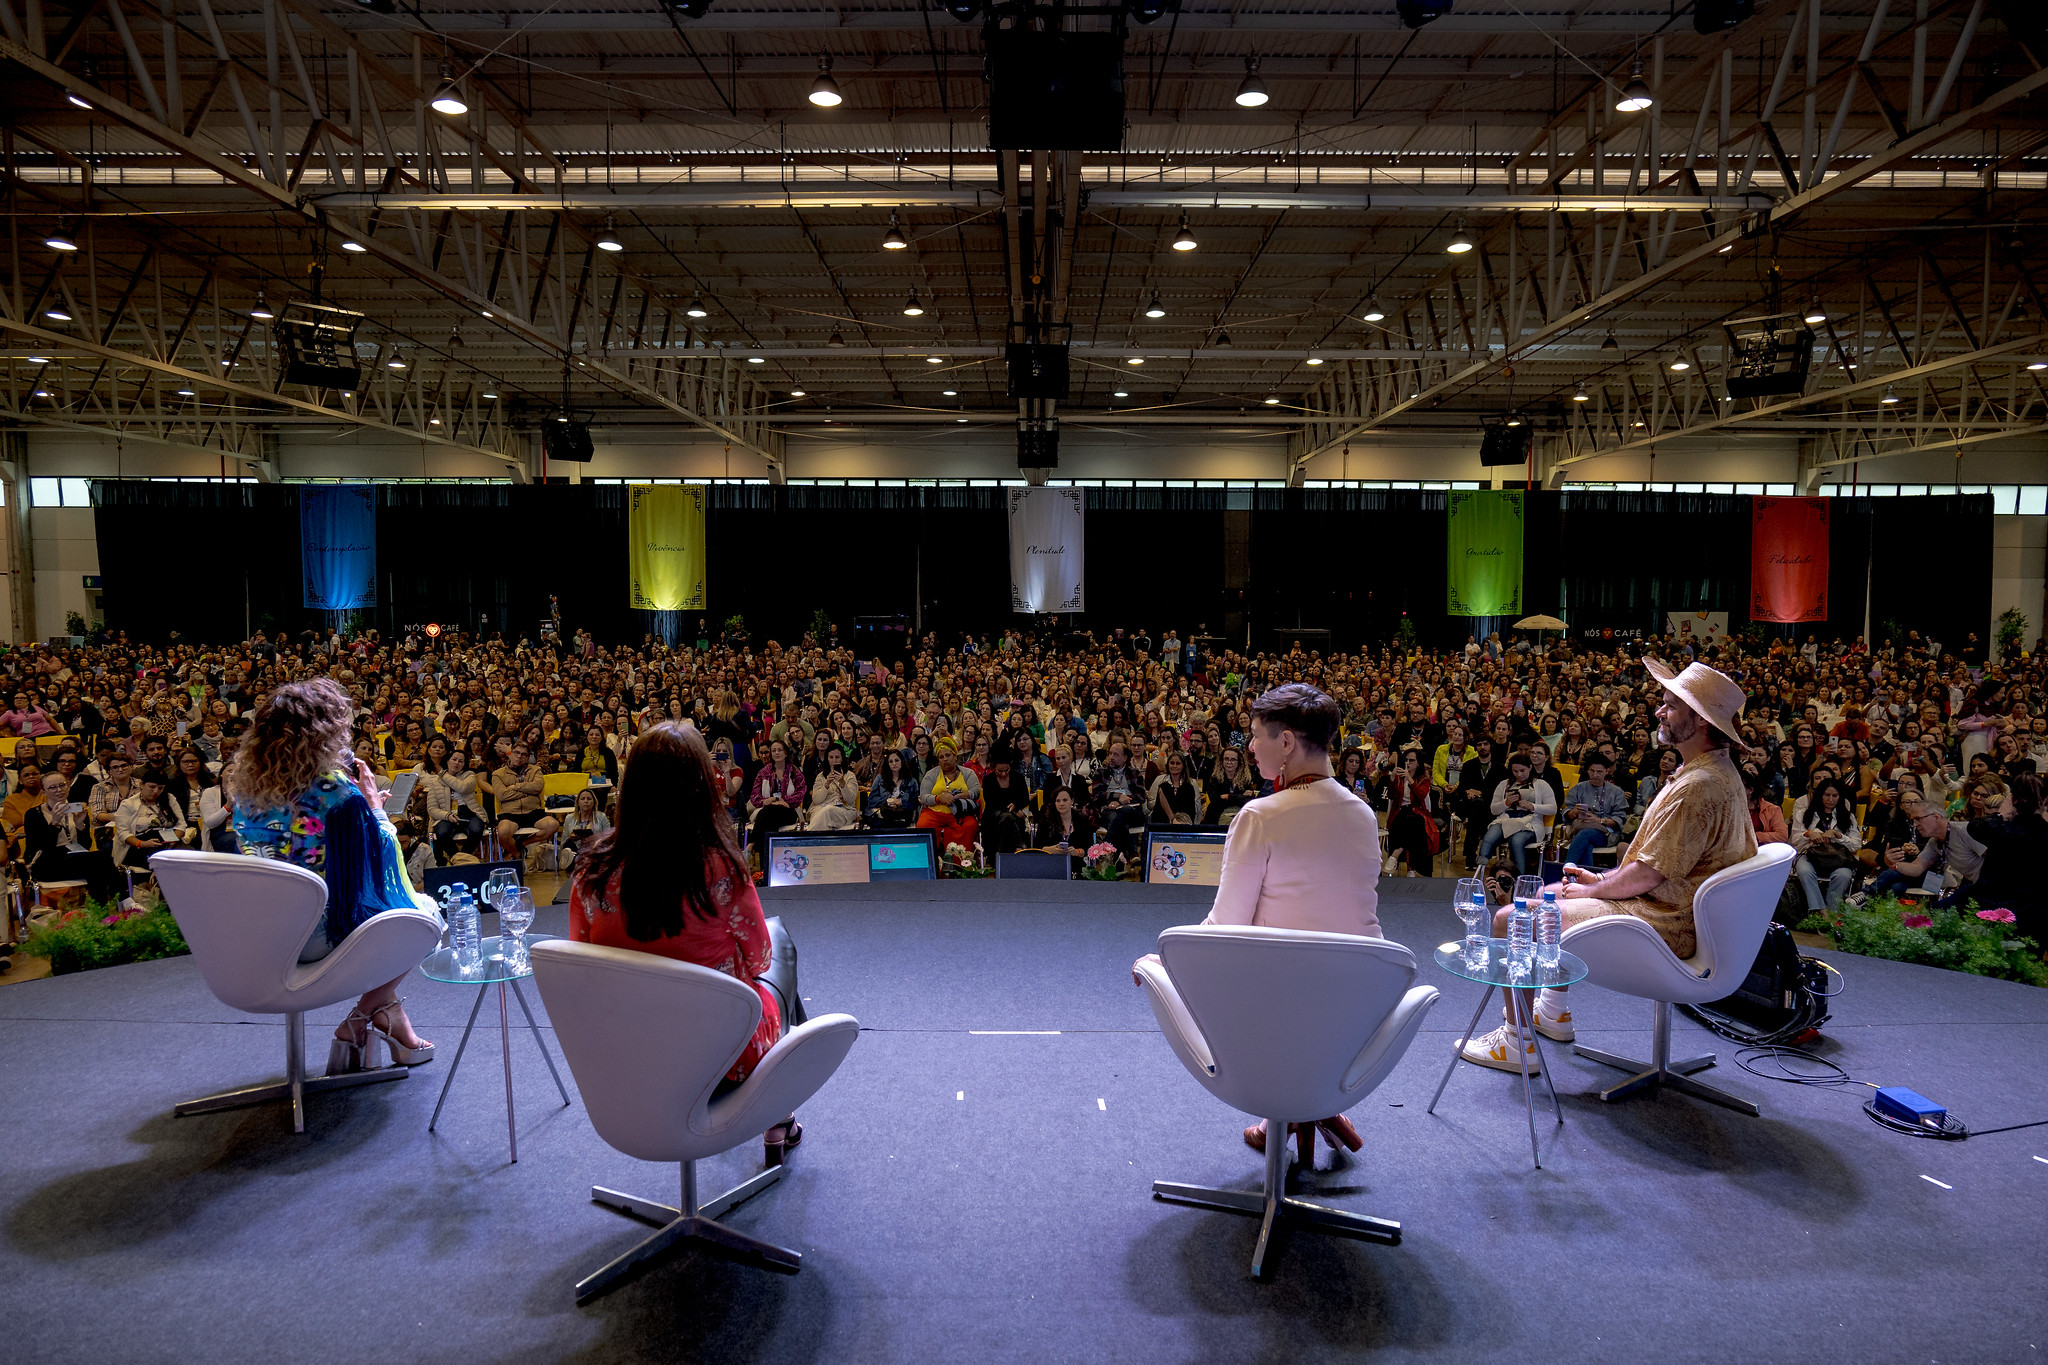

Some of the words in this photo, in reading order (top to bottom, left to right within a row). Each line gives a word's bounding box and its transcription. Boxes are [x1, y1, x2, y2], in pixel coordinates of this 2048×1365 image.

[1026, 545, 1066, 555] Plenitude
[440, 622, 460, 632] CAFÉ
[1584, 628, 1601, 638] NÓS
[1614, 628, 1642, 638] CAFÉ
